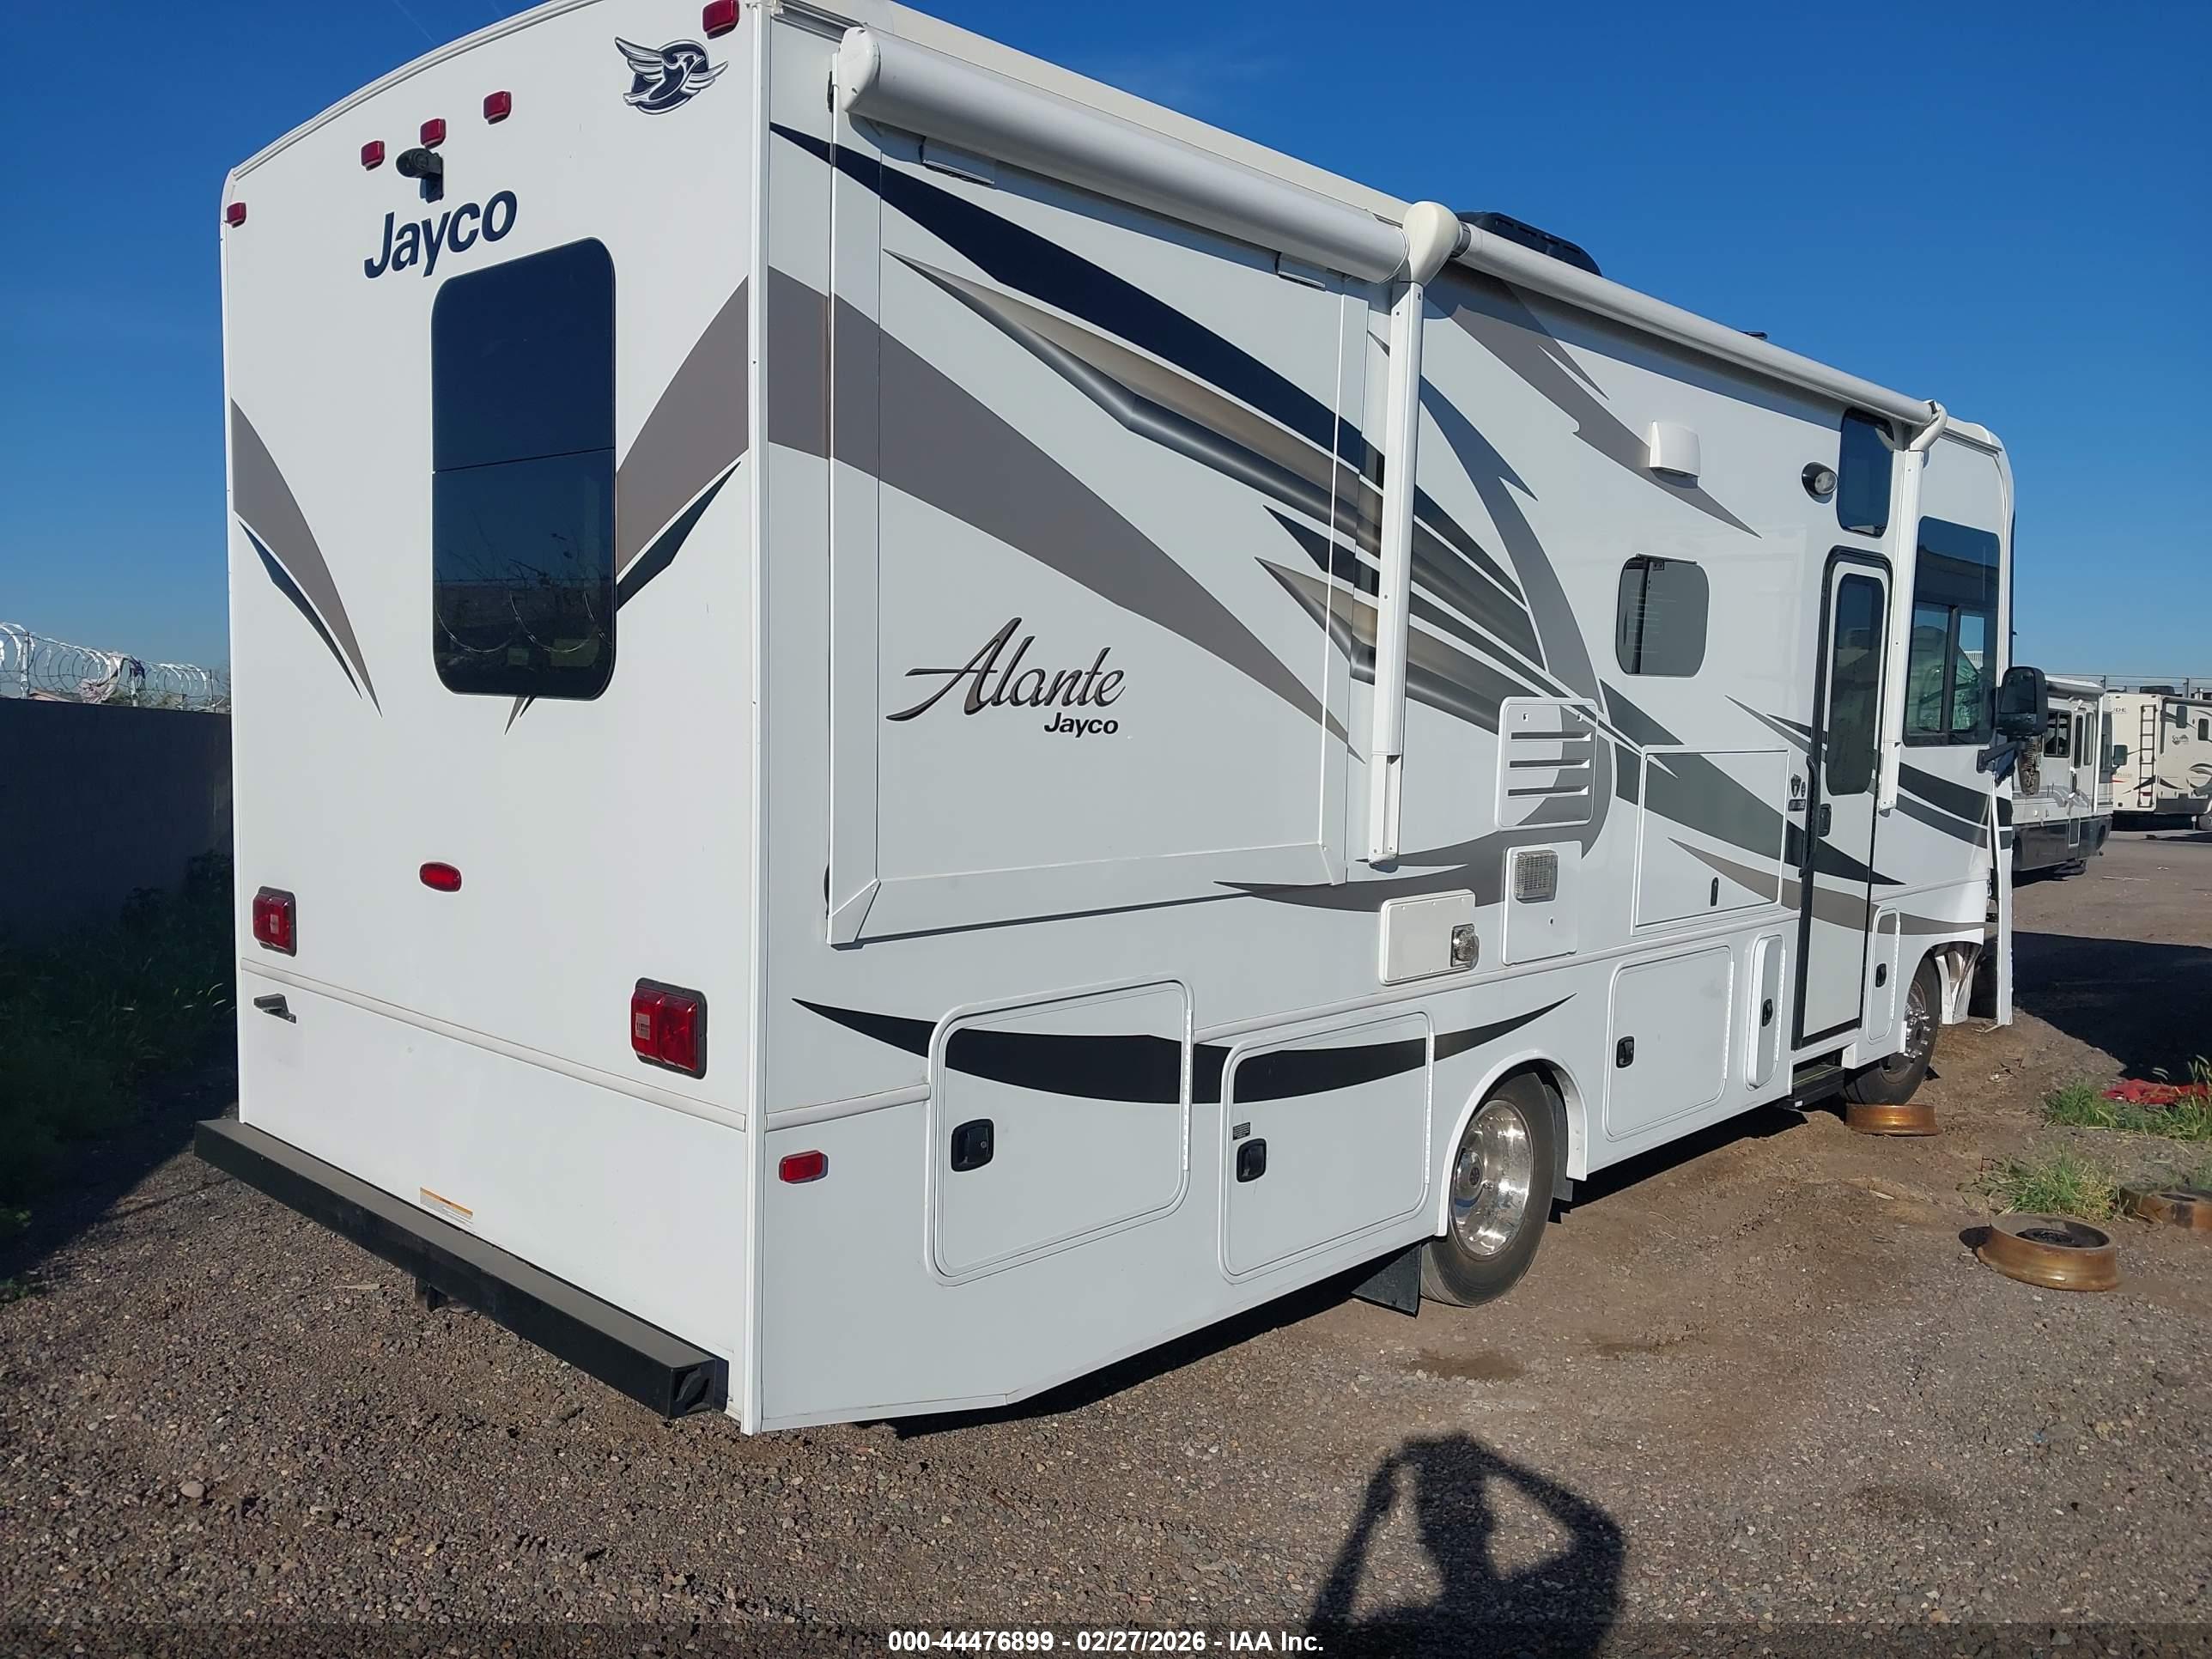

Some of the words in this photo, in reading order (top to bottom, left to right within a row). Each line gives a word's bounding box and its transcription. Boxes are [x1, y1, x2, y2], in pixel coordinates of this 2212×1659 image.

[364, 190, 518, 279] Jayco
[886, 617, 1126, 721] Alante
[1044, 712, 1119, 738] Jayco
